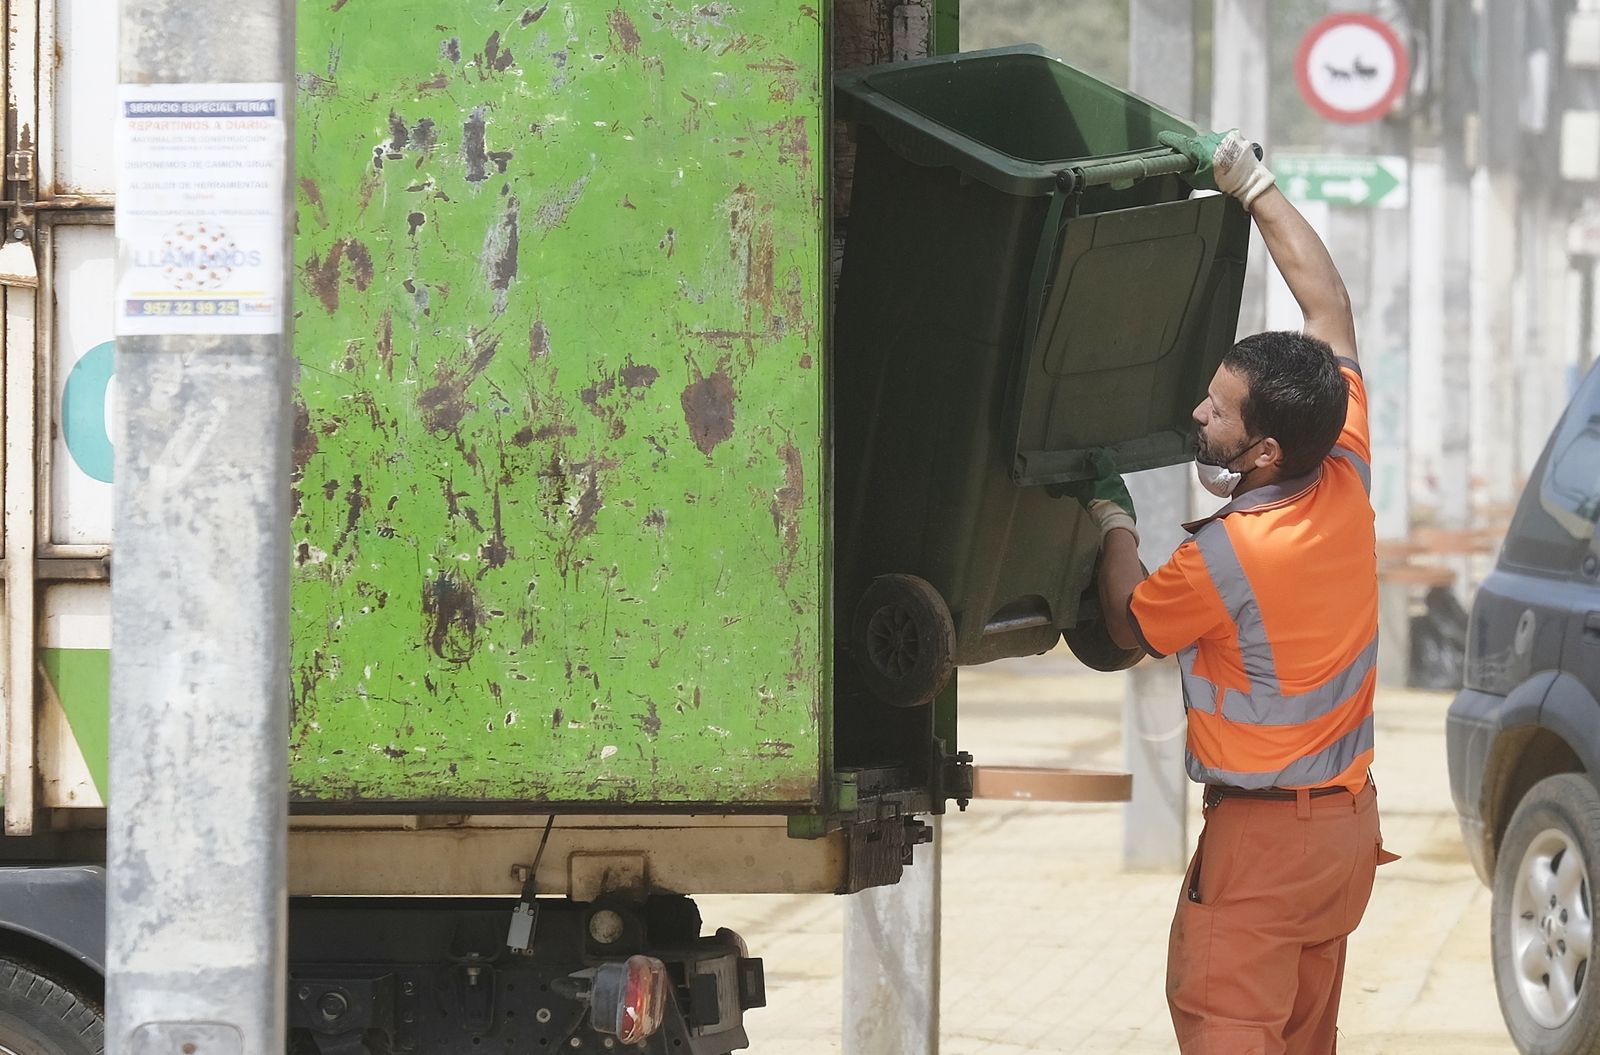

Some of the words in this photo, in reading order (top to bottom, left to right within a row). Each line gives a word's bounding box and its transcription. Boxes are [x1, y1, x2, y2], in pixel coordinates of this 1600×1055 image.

[129, 102, 178, 113] SERVICIO
[182, 102, 234, 113] ESPECIAL
[235, 101, 268, 112] FERIA
[128, 120, 209, 131] REPARTIMOS
[214, 121, 222, 130] A
[225, 120, 269, 130] DIARIO
